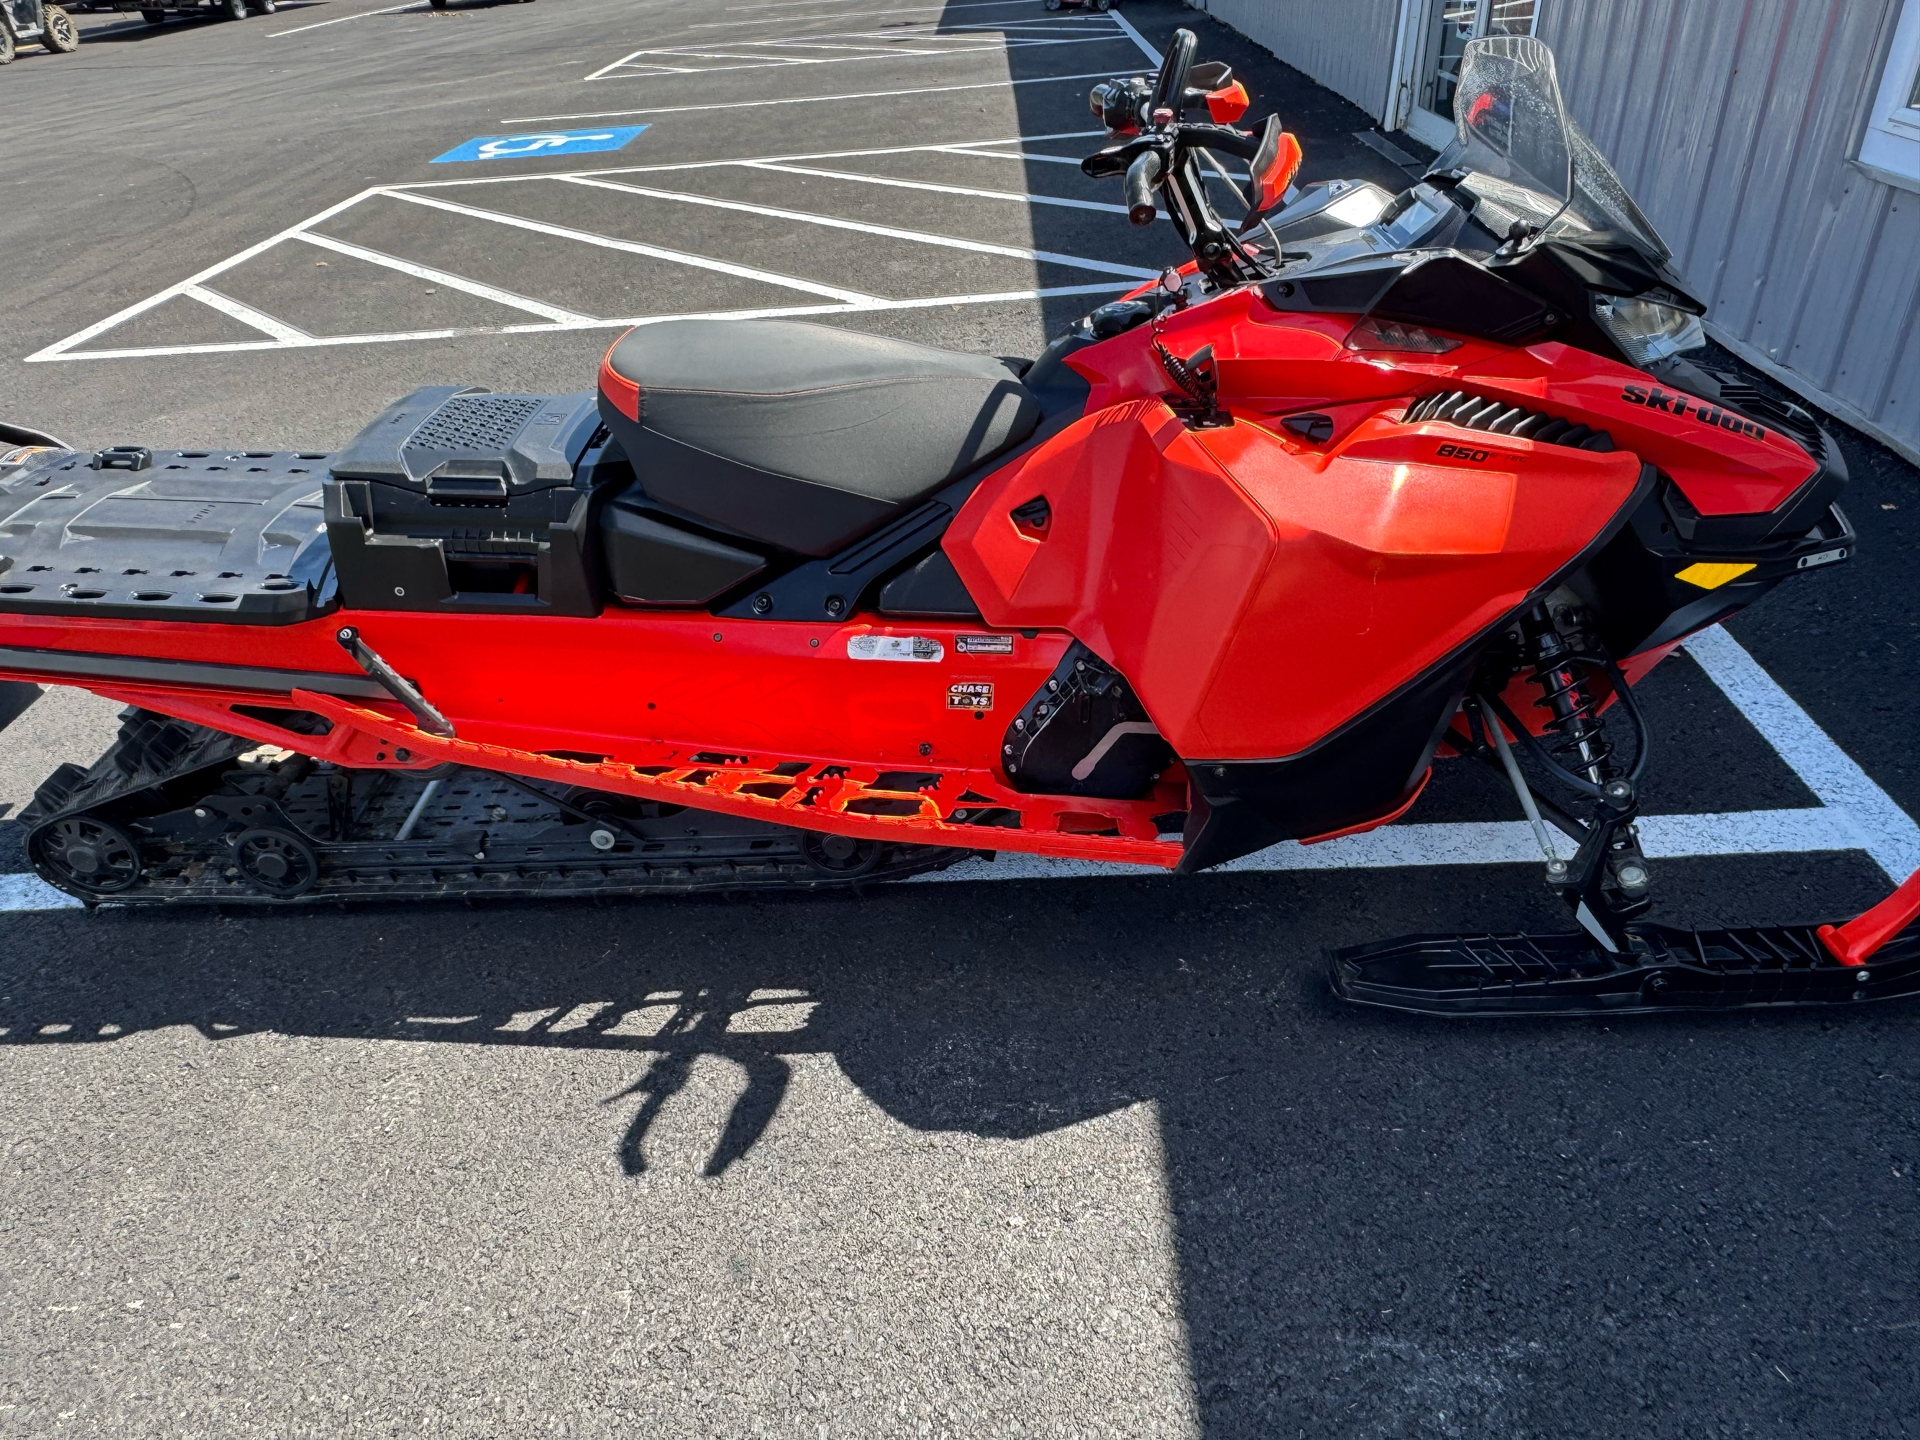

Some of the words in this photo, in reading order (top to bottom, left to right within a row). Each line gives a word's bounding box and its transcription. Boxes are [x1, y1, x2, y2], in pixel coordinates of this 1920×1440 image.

[1620, 385, 1766, 441] ski-doo
[1436, 444, 1490, 462] 850
[950, 685, 990, 693] CHASE
